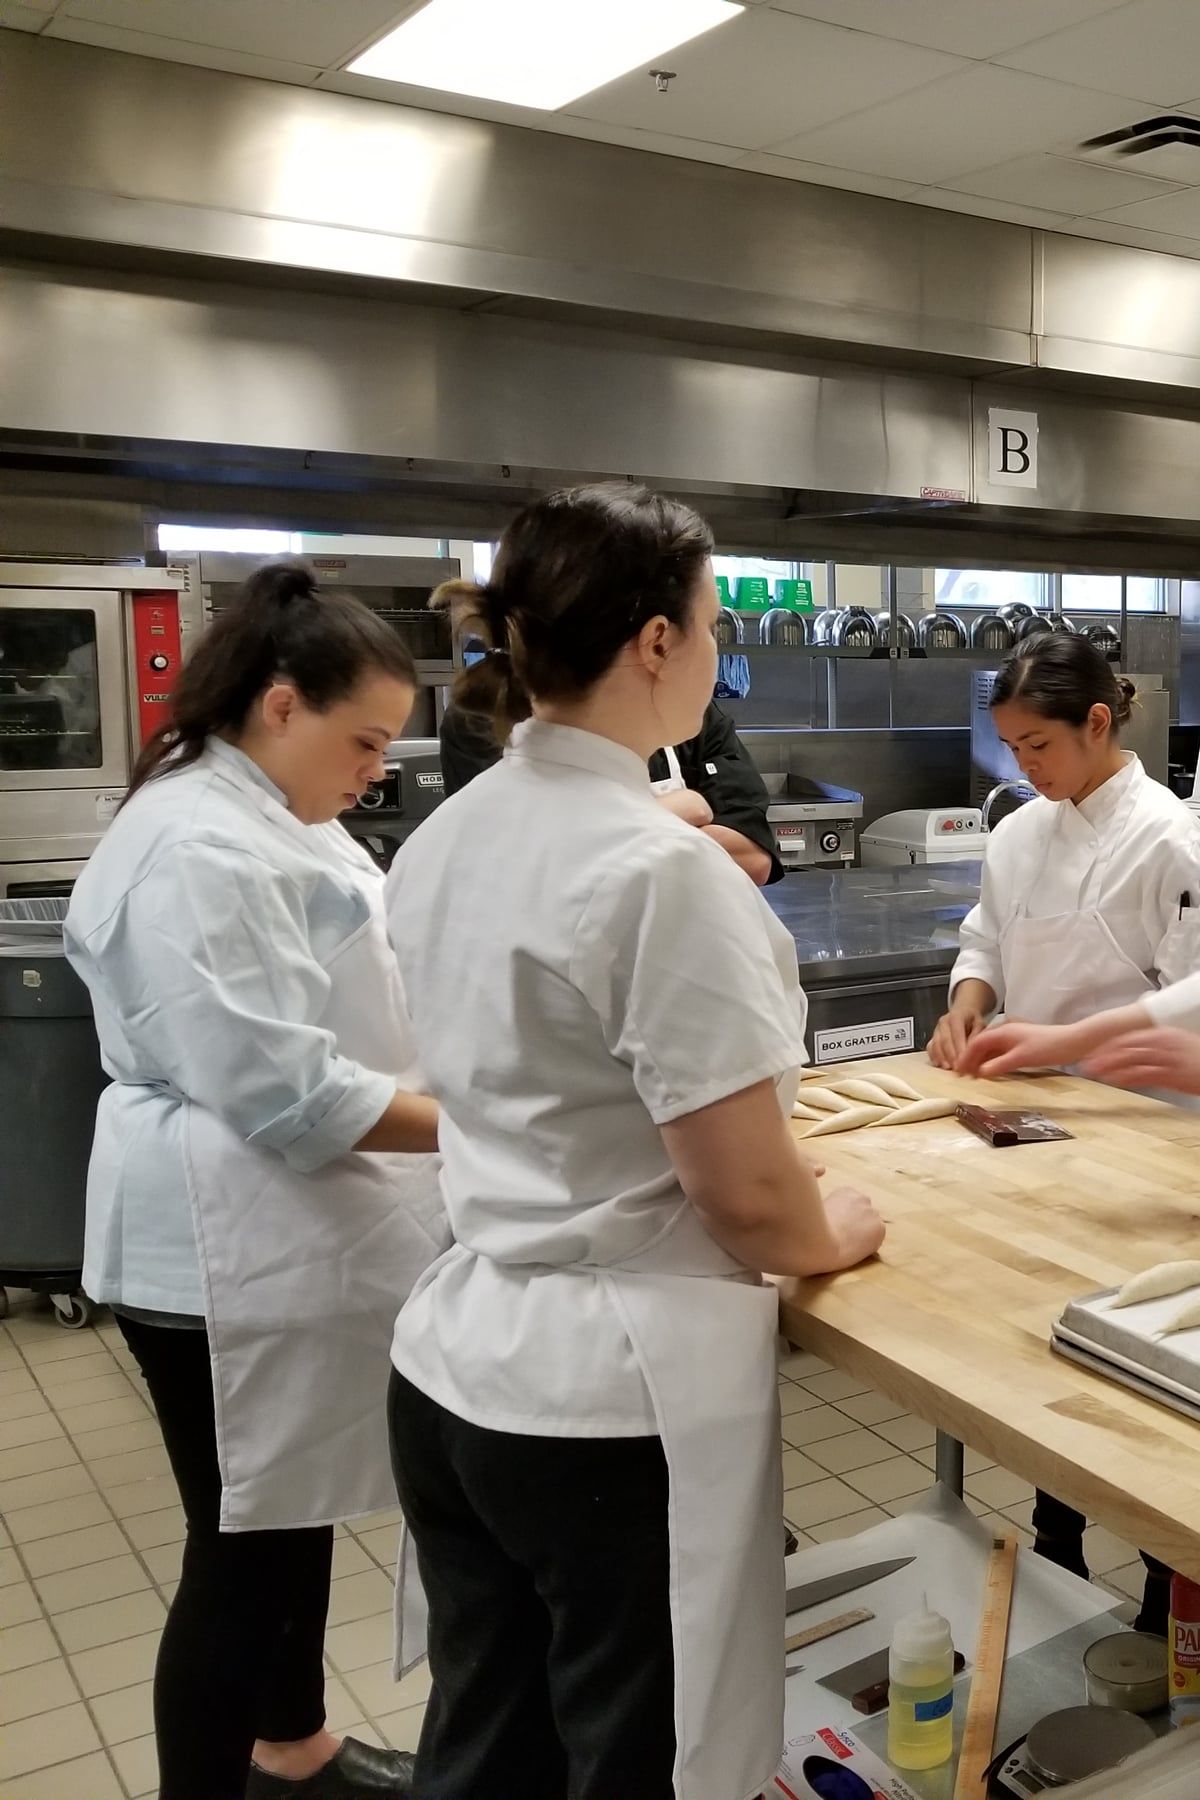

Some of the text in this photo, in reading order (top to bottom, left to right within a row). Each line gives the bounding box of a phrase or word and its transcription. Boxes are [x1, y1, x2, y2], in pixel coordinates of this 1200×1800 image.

[997, 426, 1030, 474] B
[144, 694, 168, 702] VULC
[821, 1041, 843, 1051] BOX
[844, 1033, 890, 1048] GRATERS
